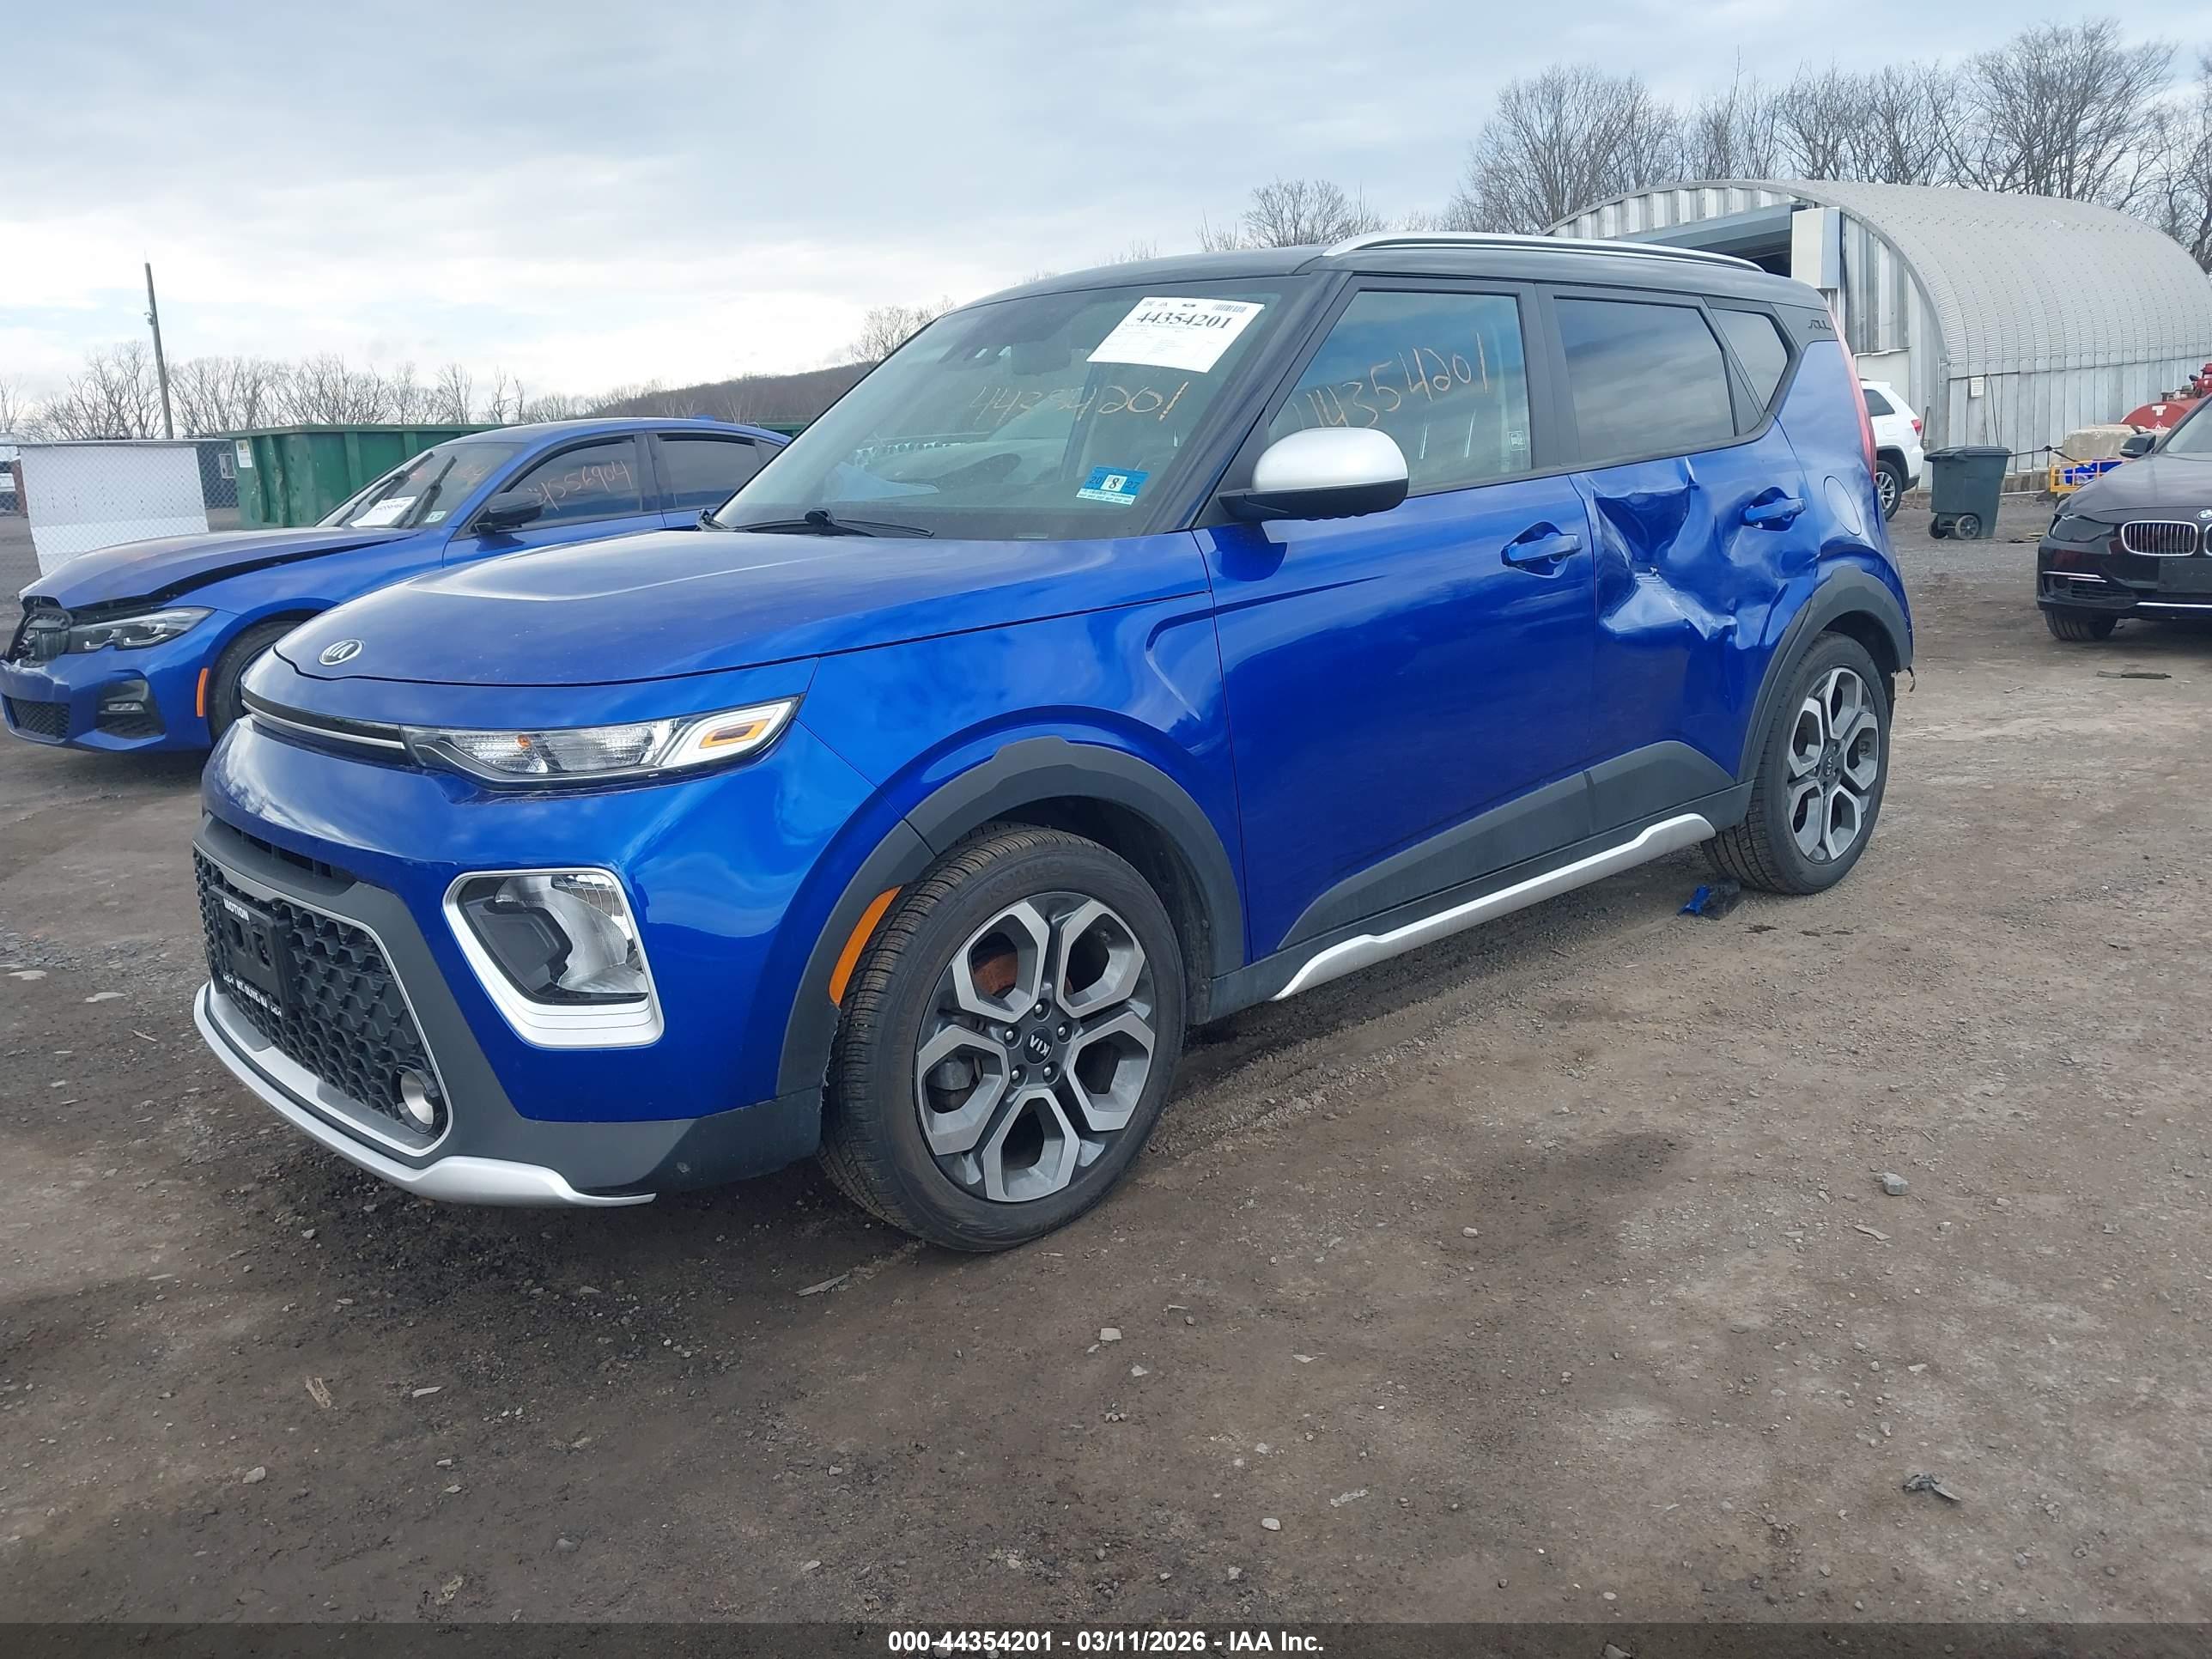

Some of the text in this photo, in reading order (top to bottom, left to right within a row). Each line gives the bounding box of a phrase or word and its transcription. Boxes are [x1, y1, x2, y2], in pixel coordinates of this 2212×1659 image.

[1136, 311, 1233, 330] 44354201
[1109, 477, 1120, 489] 8
[1127, 481, 1141, 489] 27
[1030, 1034, 1050, 1057] KIA
